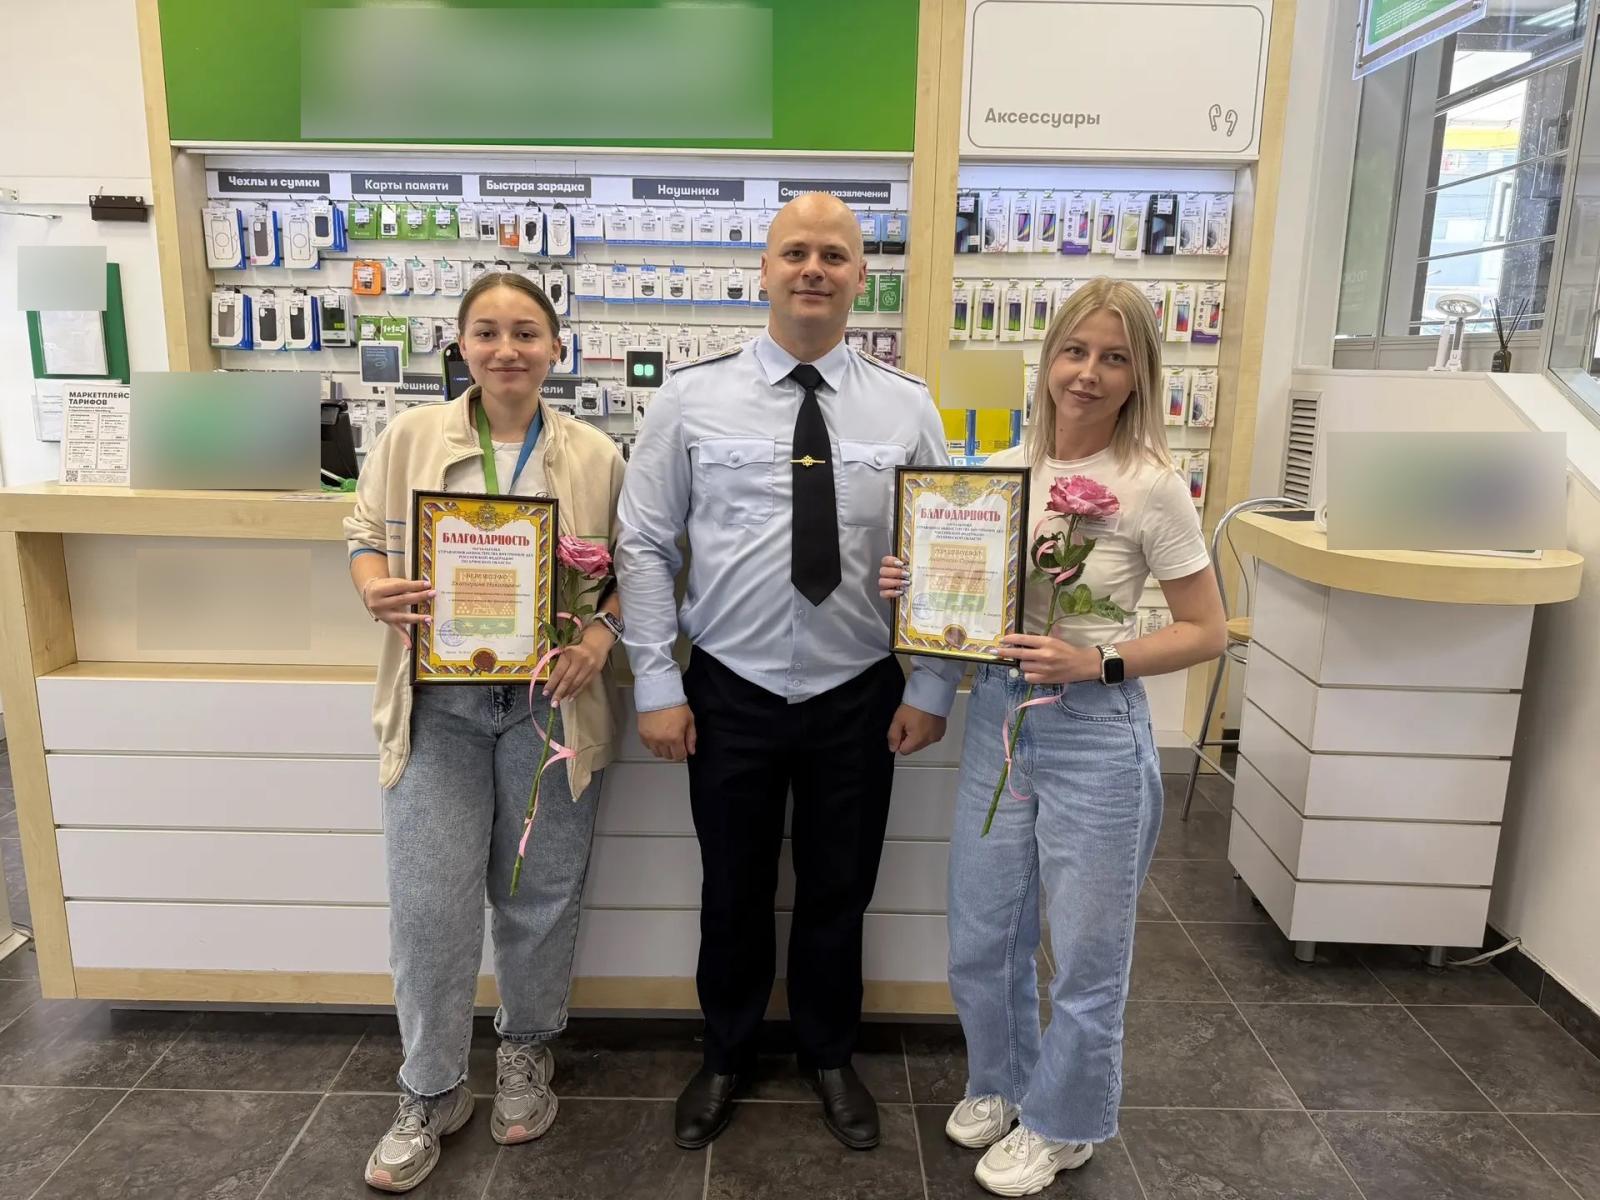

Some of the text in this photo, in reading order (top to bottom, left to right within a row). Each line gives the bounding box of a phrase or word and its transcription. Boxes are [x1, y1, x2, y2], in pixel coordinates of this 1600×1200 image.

[984, 107, 1101, 128] Аксессуары
[228, 175, 320, 189] Чехлы и сумки
[364, 179, 450, 192] Карты памяти
[486, 180, 585, 193] Быстрая зарядка
[657, 184, 720, 198] Наушники
[382, 324, 406, 333] 1+1=3
[68, 391, 130, 399] МАРКЕТПЛЕЙС
[68, 398, 108, 406] ТАРИФОВ
[920, 507, 1001, 522] БЛАГОДАРНОСТЬ
[443, 532, 530, 546] БЛАГОДАРНОСТЬ
